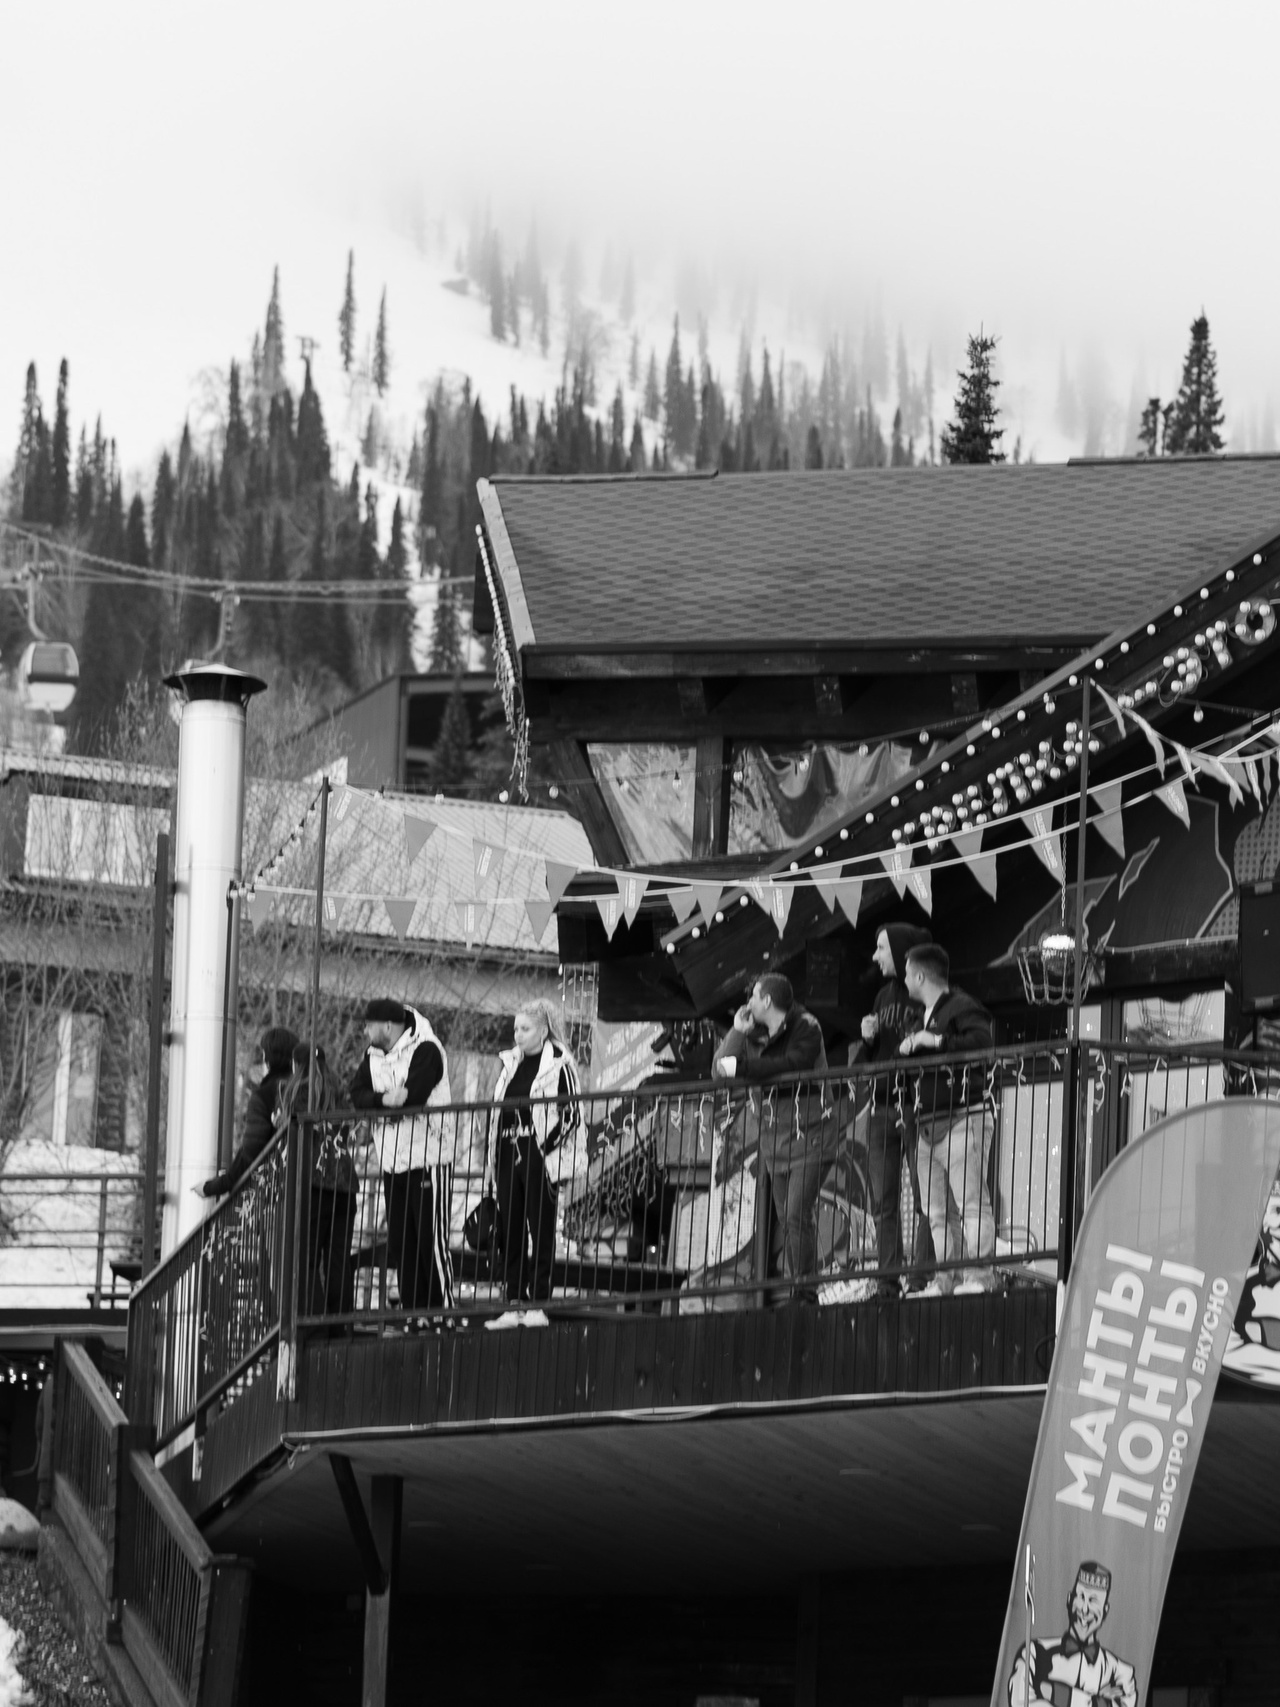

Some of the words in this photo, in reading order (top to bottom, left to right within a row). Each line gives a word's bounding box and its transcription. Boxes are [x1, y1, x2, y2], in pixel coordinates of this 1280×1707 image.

[1055, 1243, 1153, 1512] МАНТЫ
[1101, 1259, 1206, 1529] ПОНТЫ
[1153, 1428, 1189, 1534] БЫСТРО
[1191, 1276, 1229, 1376] ВКУСНО
